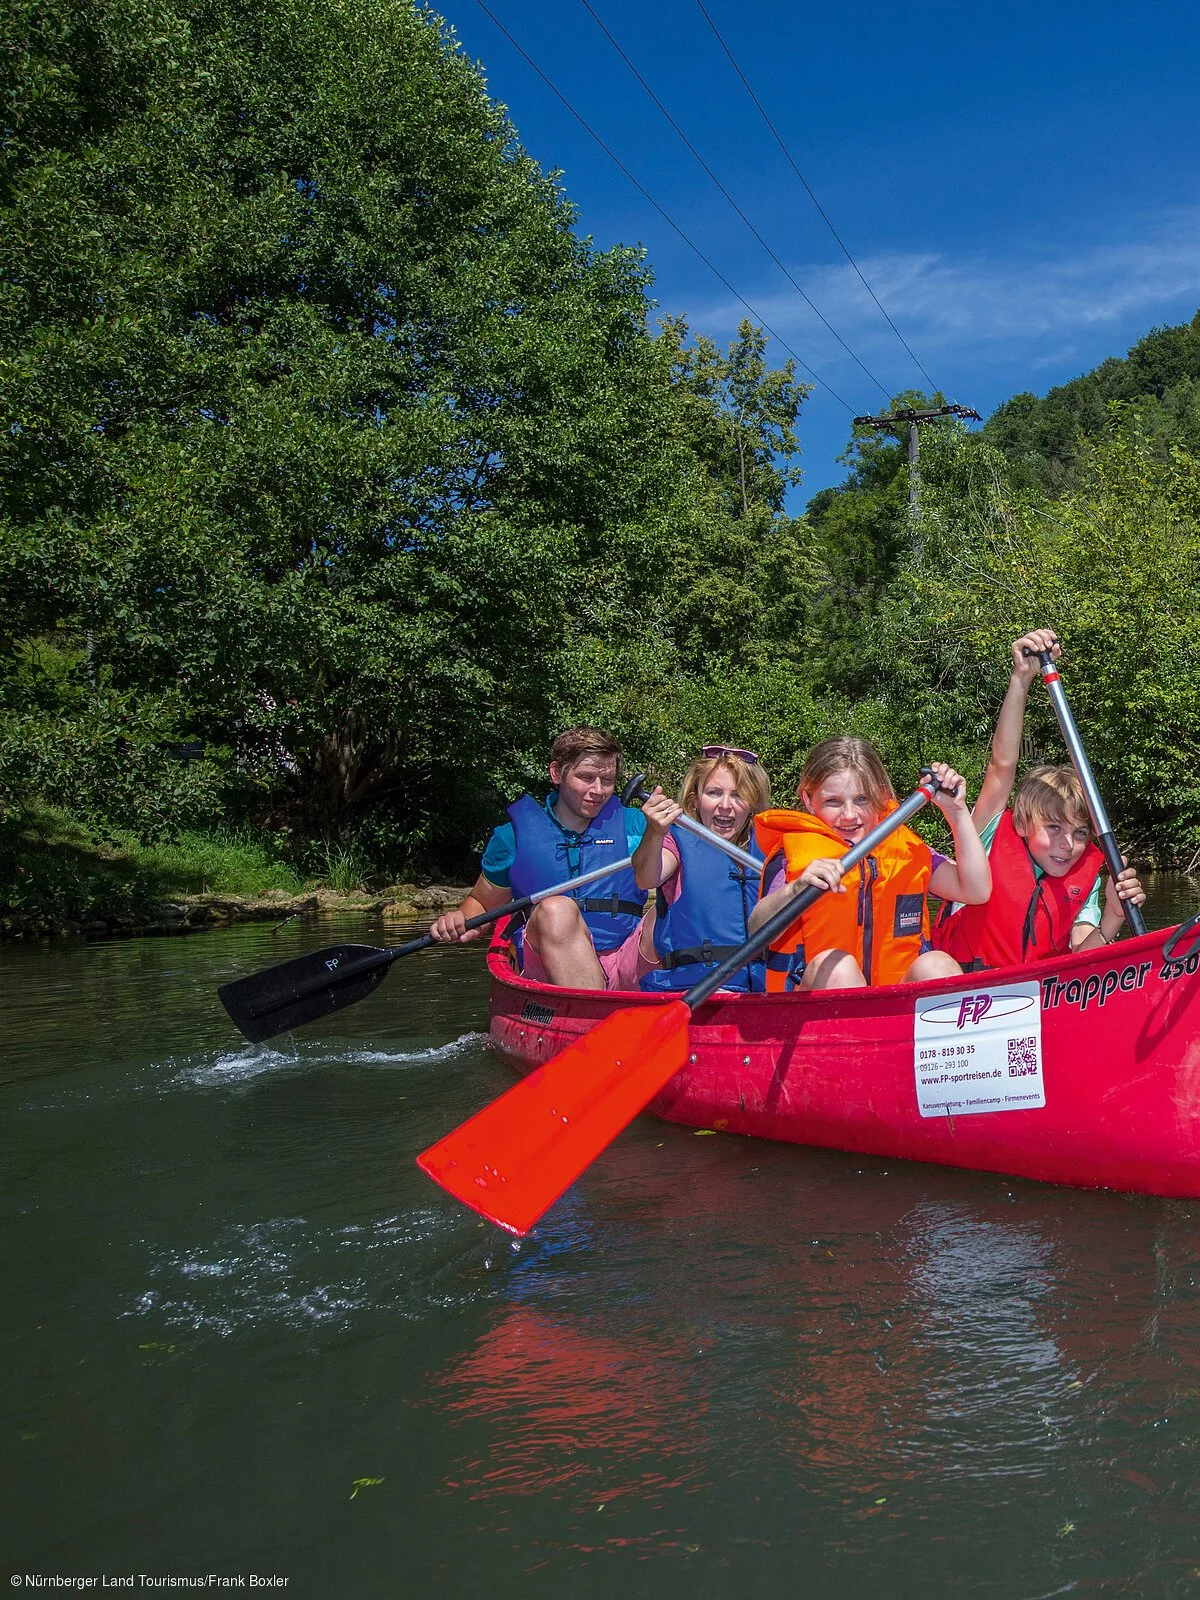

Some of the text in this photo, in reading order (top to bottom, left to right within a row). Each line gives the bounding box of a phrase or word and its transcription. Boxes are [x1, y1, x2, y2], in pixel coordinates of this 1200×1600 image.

[325, 958, 339, 971] FP
[1041, 953, 1200, 1010] Trapper 450
[957, 994, 993, 1030] FP
[919, 1049, 937, 1060] 0178
[941, 1047, 955, 1057] 819
[956, 1046, 965, 1055] 30
[966, 1045, 975, 1054] 35
[920, 1062, 939, 1072] 09126
[944, 1061, 956, 1070] 293
[957, 1059, 969, 1068] 100
[920, 1069, 1002, 1084] www.FP-sportreisen.de
[922, 1101, 962, 1109] Kanuvermietung
[966, 1096, 1001, 1105] Familiencamp
[1004, 1093, 1040, 1102] Firmenevents
